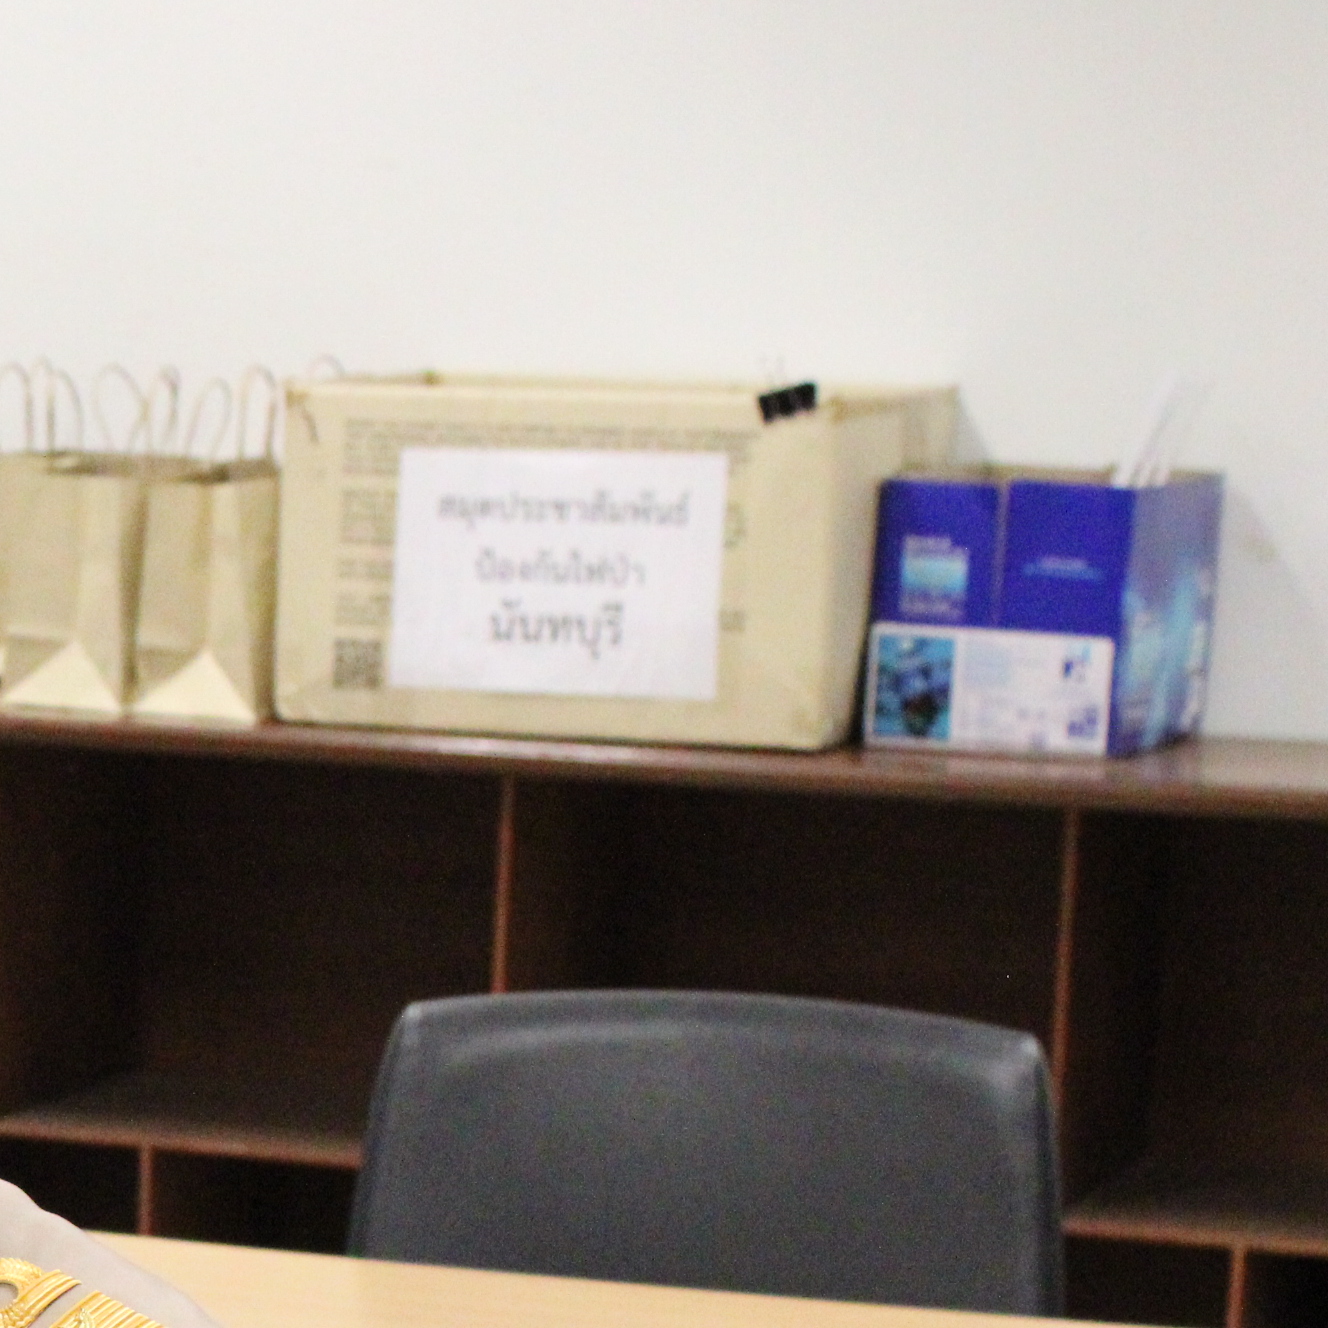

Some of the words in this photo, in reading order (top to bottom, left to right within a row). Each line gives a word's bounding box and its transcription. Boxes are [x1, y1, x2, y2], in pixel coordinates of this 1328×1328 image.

[438, 489, 690, 530] สมุดประชาสัมพันธ์
[490, 597, 626, 660] นันทบุรี
